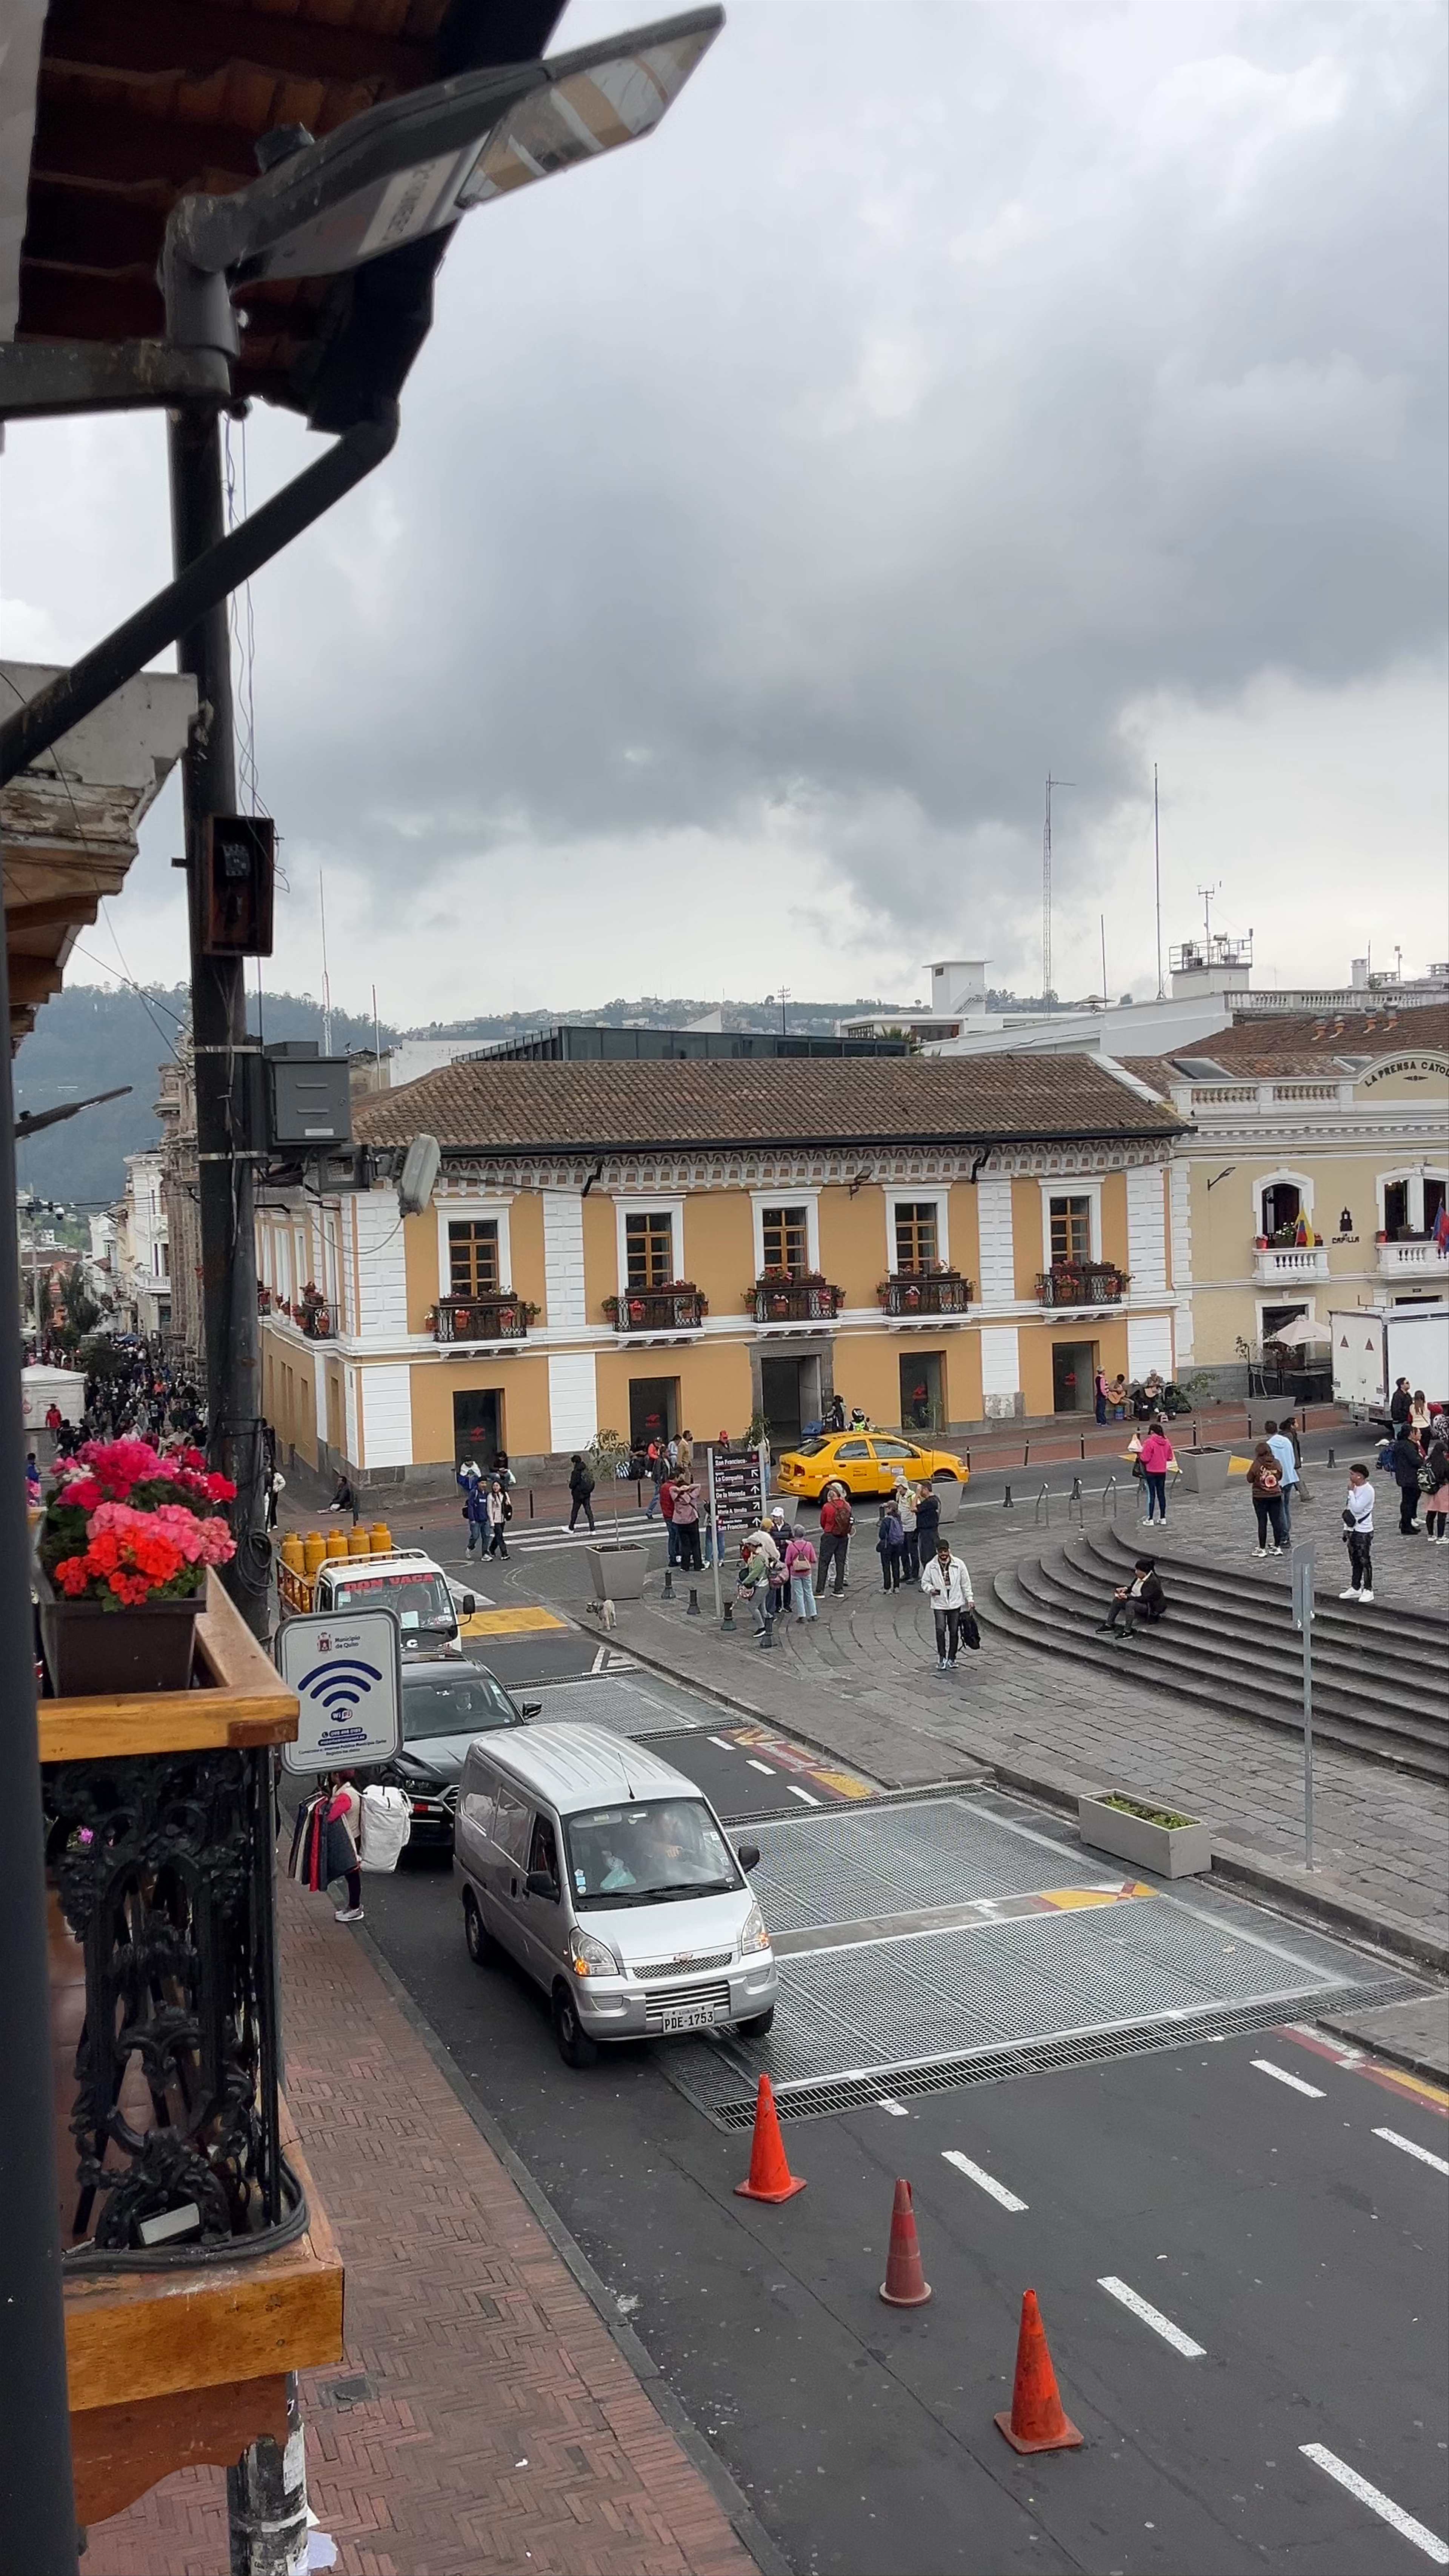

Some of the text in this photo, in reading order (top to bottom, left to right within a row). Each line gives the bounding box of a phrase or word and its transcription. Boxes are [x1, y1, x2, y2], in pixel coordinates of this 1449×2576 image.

[1364, 1075, 1378, 1087] LA
[1378, 1061, 1417, 1078] PRENSA
[343, 1574, 435, 1591] DON VACA
[665, 2011, 714, 2030] PDE-1753
